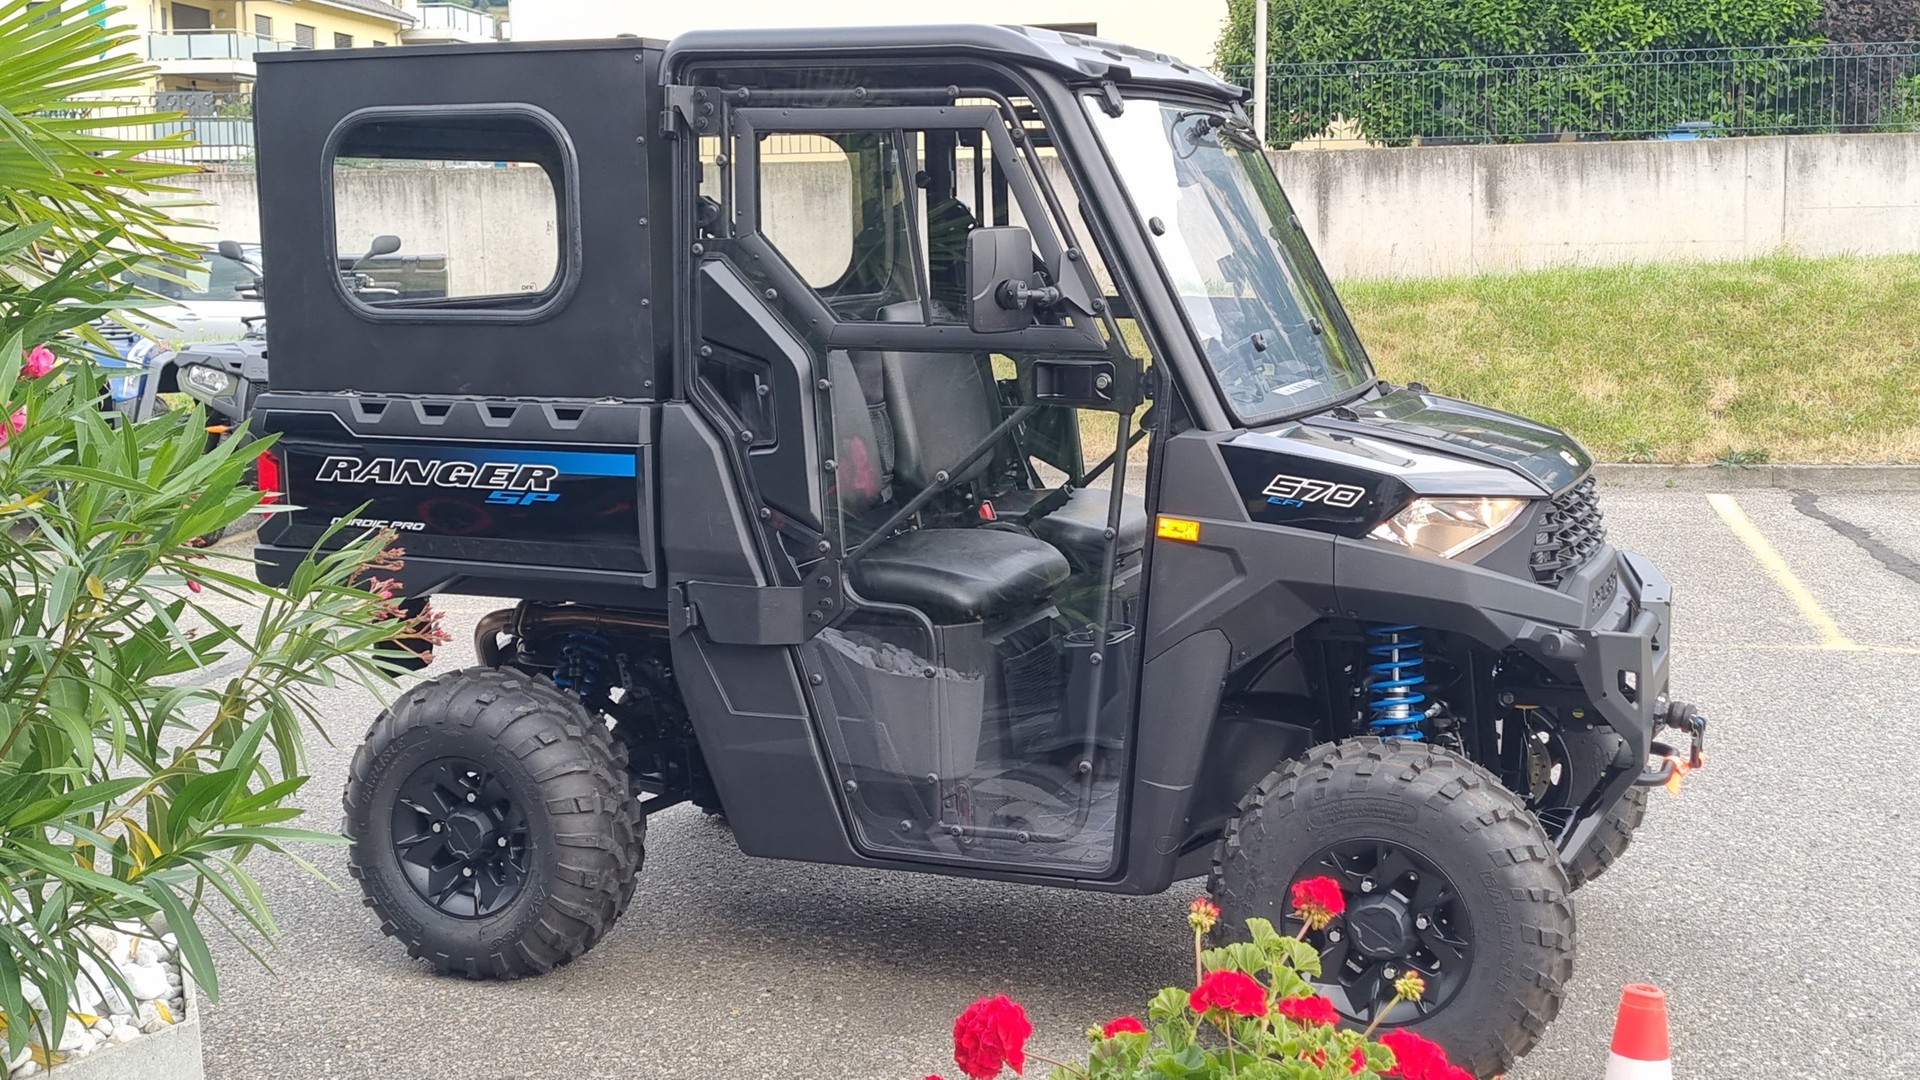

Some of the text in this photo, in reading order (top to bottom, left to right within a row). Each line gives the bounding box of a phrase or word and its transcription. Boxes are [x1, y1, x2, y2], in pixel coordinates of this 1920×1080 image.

[315, 455, 558, 491] RANGER
[484, 490, 561, 506] SP
[1262, 474, 1366, 508] 570
[1266, 496, 1305, 509] EFI
[330, 517, 426, 531] NRDIC PRO
